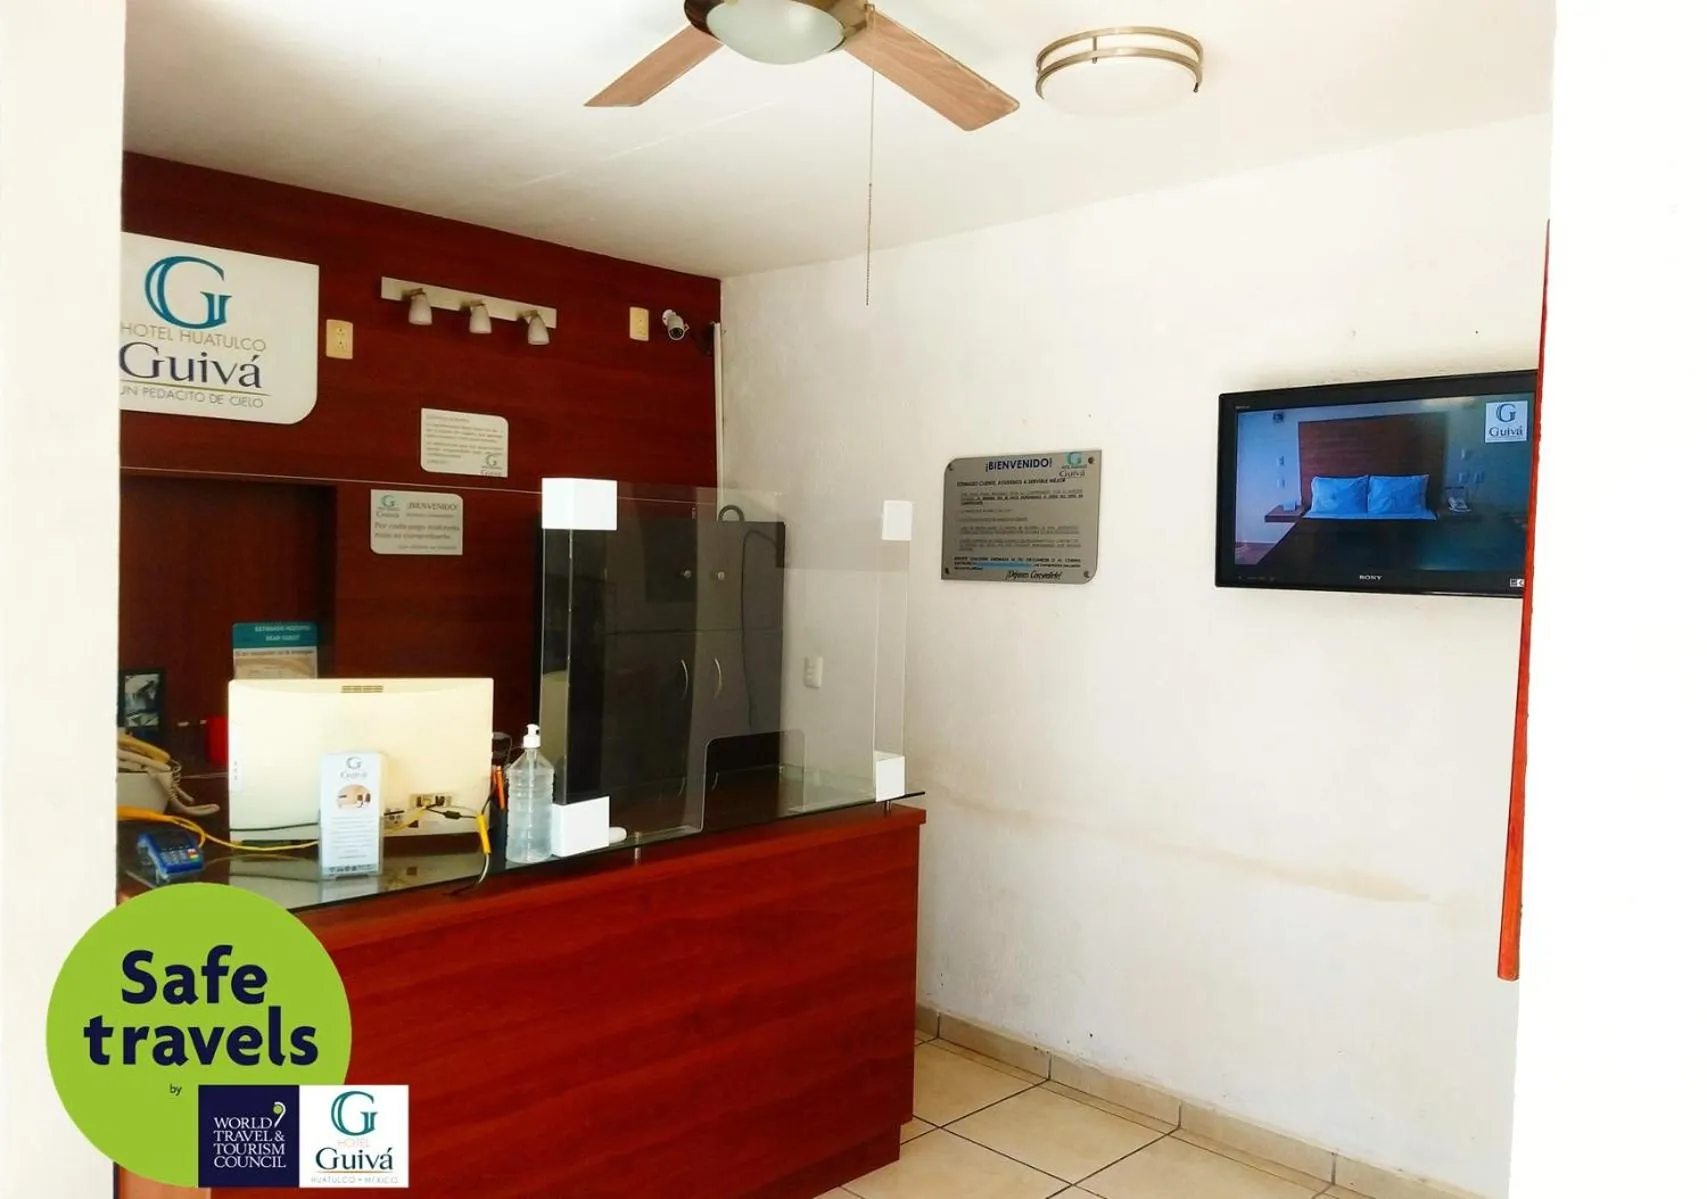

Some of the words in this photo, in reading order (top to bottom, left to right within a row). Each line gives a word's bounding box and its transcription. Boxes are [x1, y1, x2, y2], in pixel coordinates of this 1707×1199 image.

[120, 322, 173, 340] HOTEL
[180, 331, 266, 352] HUATULCO
[119, 341, 262, 388] Guivá
[142, 386, 205, 403] PEDACITO
[209, 394, 224, 404] DE
[229, 396, 264, 409] CIELO
[986, 458, 1052, 472] ¡BIENVENIDO!
